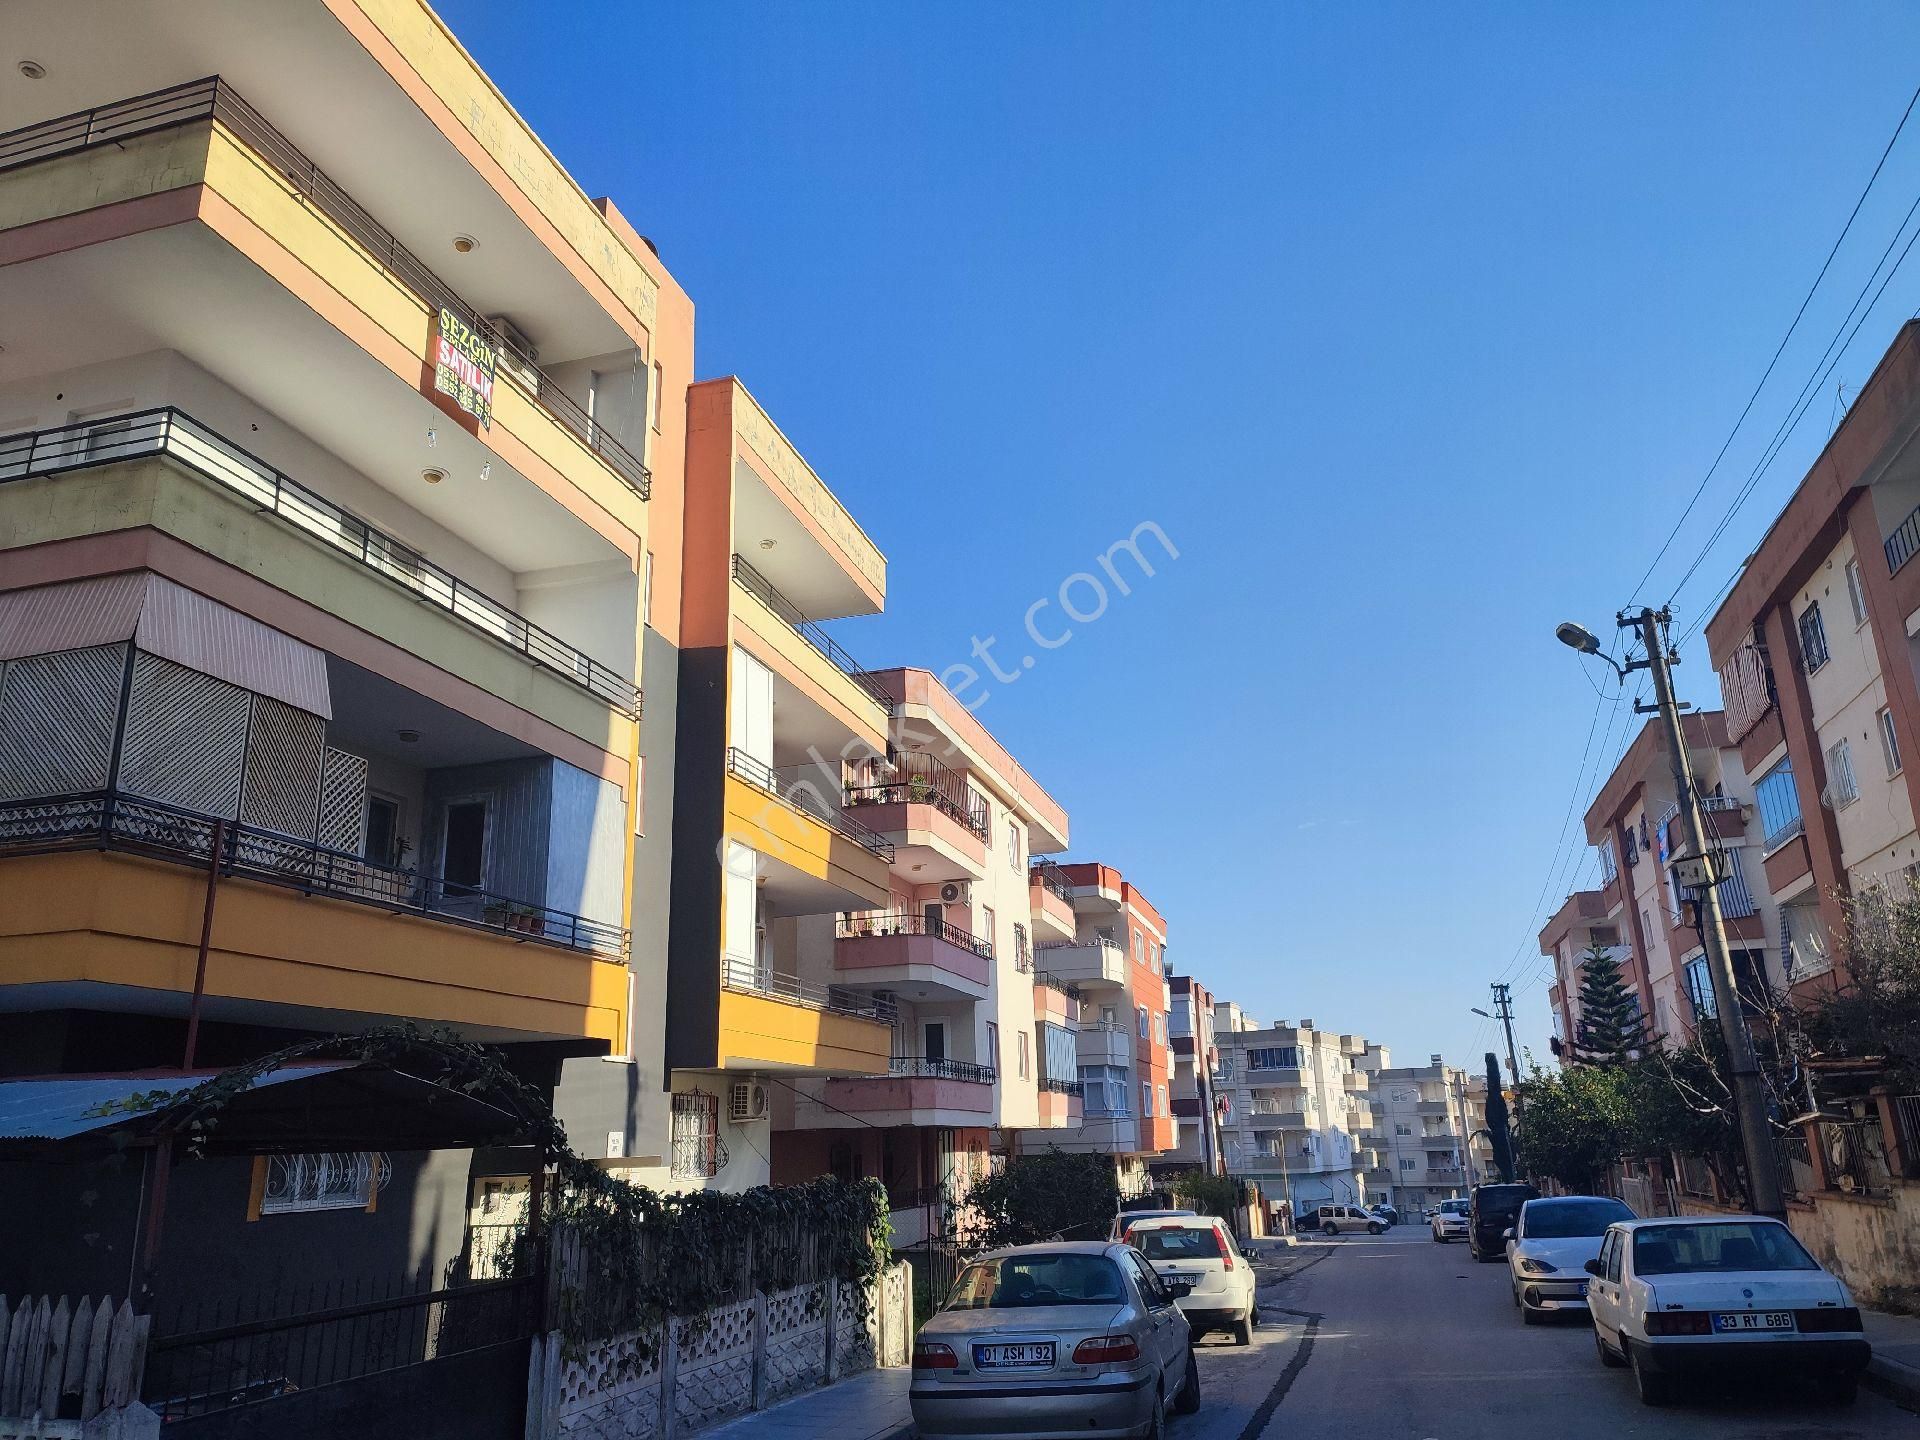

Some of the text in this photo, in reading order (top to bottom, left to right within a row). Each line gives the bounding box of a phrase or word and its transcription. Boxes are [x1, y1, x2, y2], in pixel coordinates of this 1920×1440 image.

[440, 339, 492, 406] SATILIK
[1720, 1313, 1791, 1329] 33 RY 686
[984, 1345, 1051, 1361] 01 ASH 192
